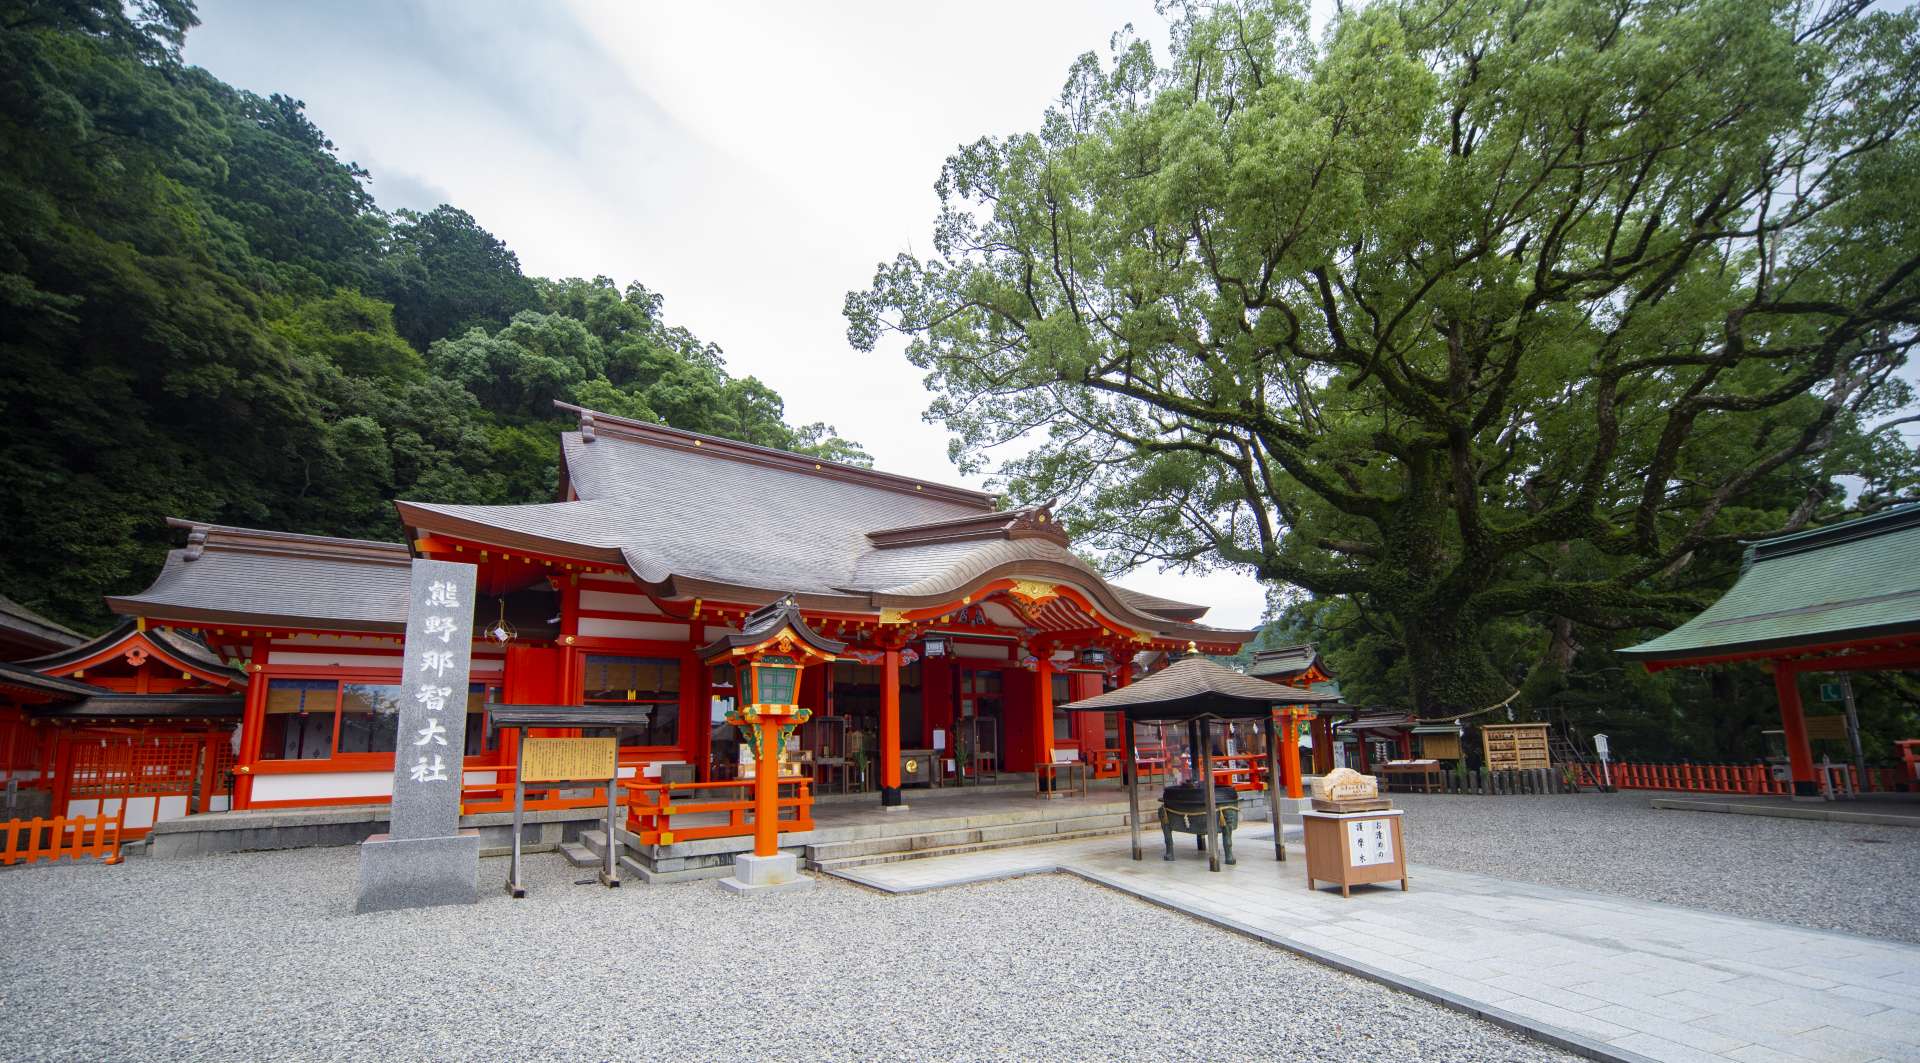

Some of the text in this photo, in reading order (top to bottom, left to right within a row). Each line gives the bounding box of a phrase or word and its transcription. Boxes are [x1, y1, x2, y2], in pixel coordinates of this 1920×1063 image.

[410, 580, 460, 783] 熊野那智大社
